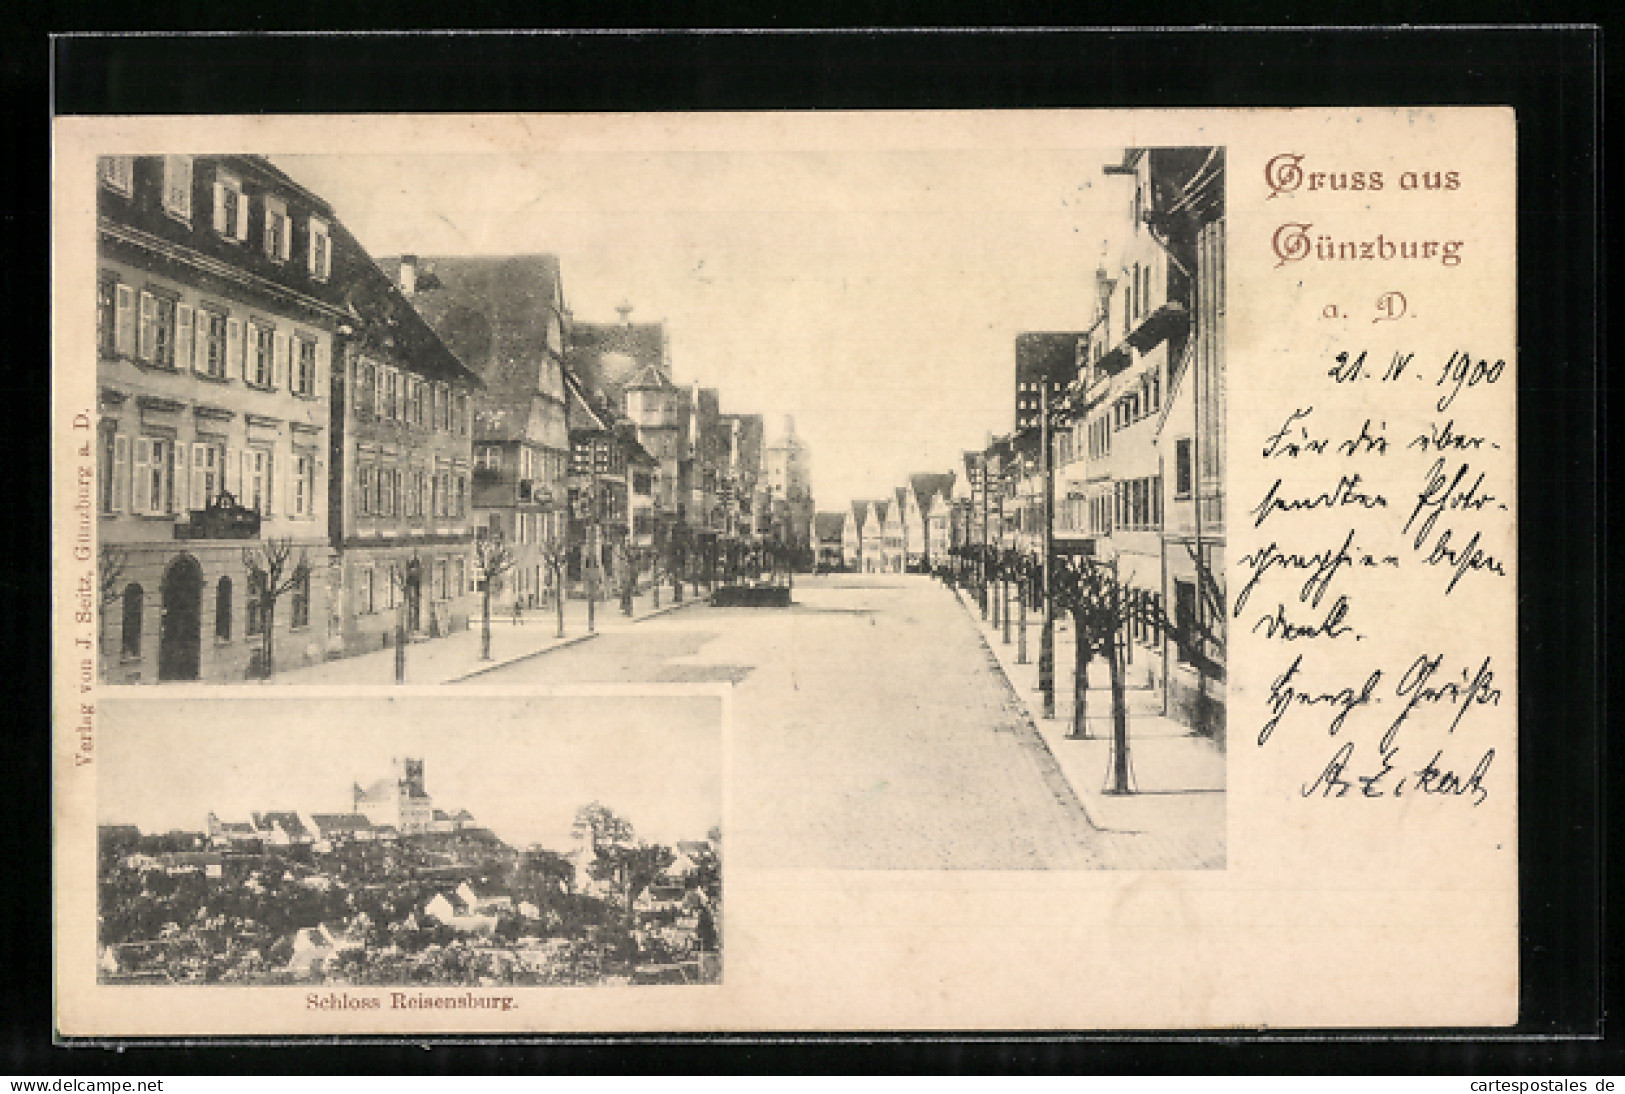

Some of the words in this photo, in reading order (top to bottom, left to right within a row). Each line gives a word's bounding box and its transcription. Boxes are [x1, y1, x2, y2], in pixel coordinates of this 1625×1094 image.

[1264, 153, 1385, 201] Gruss
[1400, 170, 1462, 191] aus
[1271, 223, 1464, 269] Günzburg
[1322, 304, 1348, 319] a.
[1371, 291, 1417, 324] D.
[1436, 351, 1506, 412] 1900
[73, 407, 91, 431] D.
[79, 659, 92, 694] von
[73, 702, 96, 767] Verlag
[305, 992, 381, 1011] Schloss
[389, 992, 519, 1012] Reisensburg.
